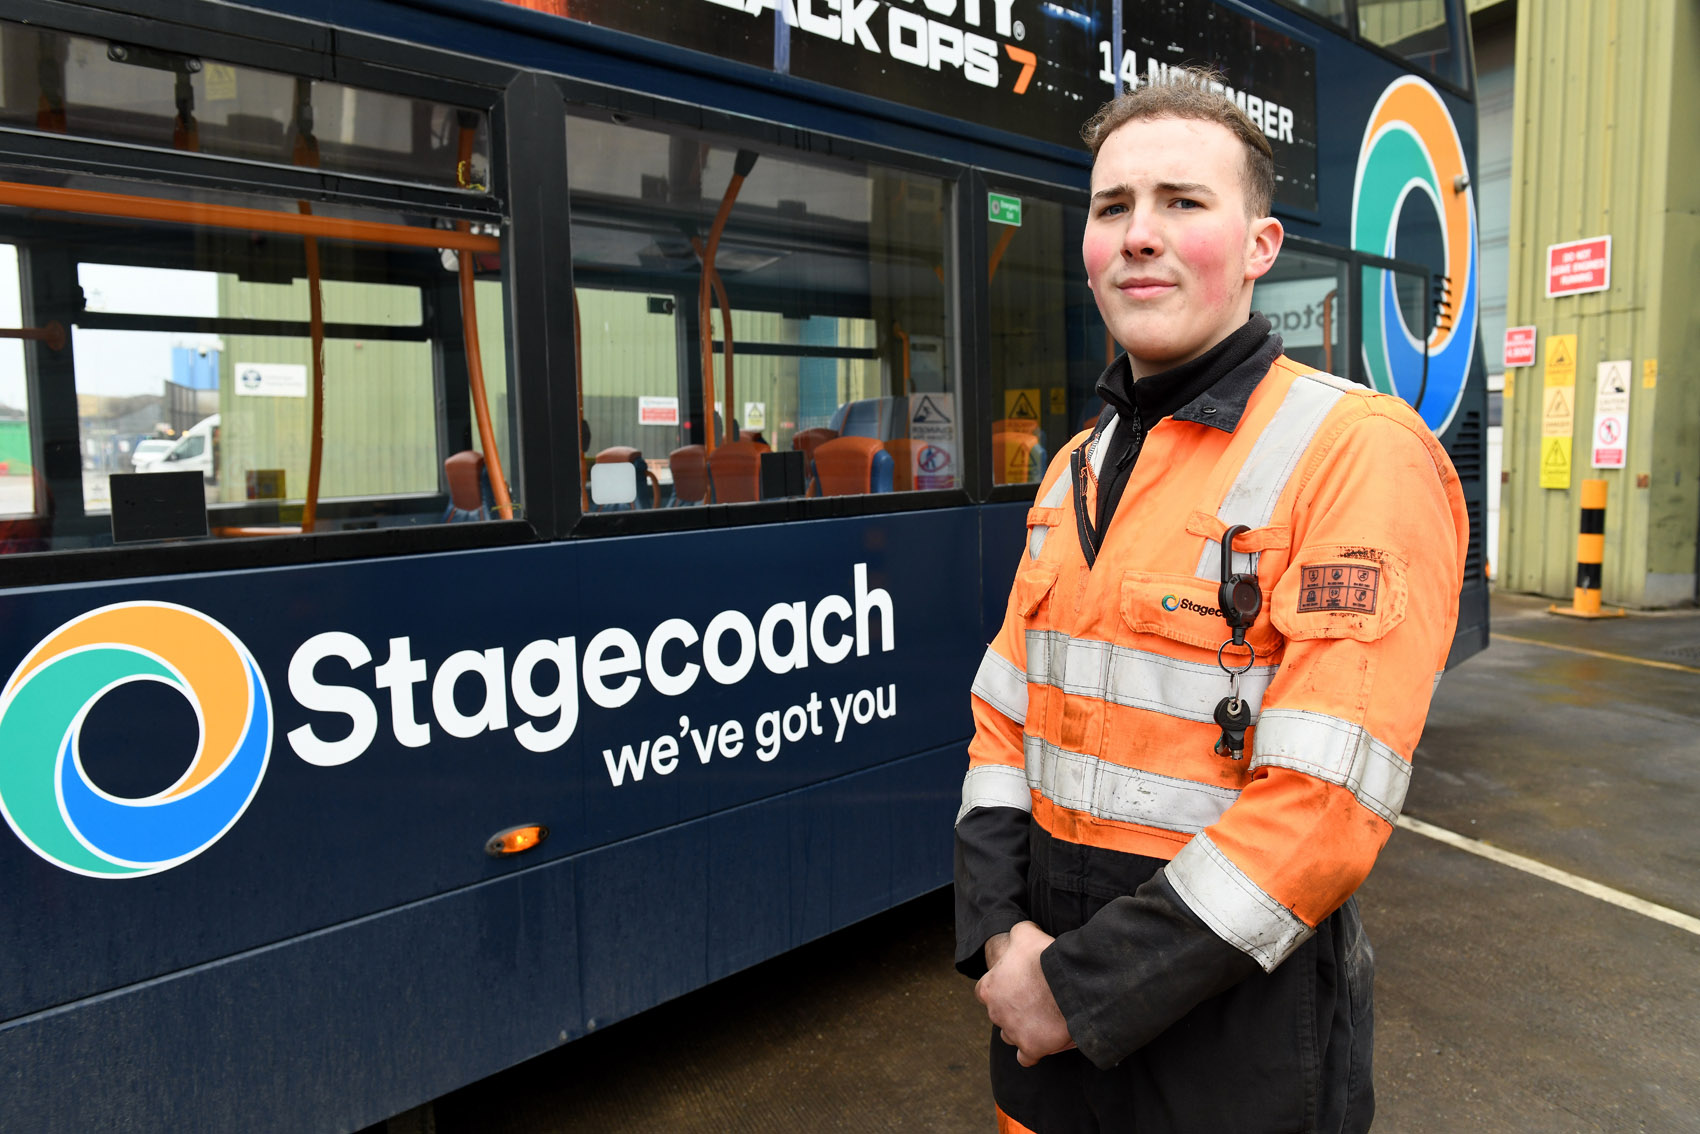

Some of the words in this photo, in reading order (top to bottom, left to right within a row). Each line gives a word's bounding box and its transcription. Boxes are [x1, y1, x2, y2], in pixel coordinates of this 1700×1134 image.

[888, 6, 999, 88] OPS
[1004, 43, 1037, 95] 7
[1099, 40, 1137, 92] 14
[1180, 598, 1227, 619] Stagec
[287, 562, 895, 767] Stagecoach
[603, 716, 744, 787] we've
[756, 692, 823, 764] got
[830, 683, 897, 743] you
